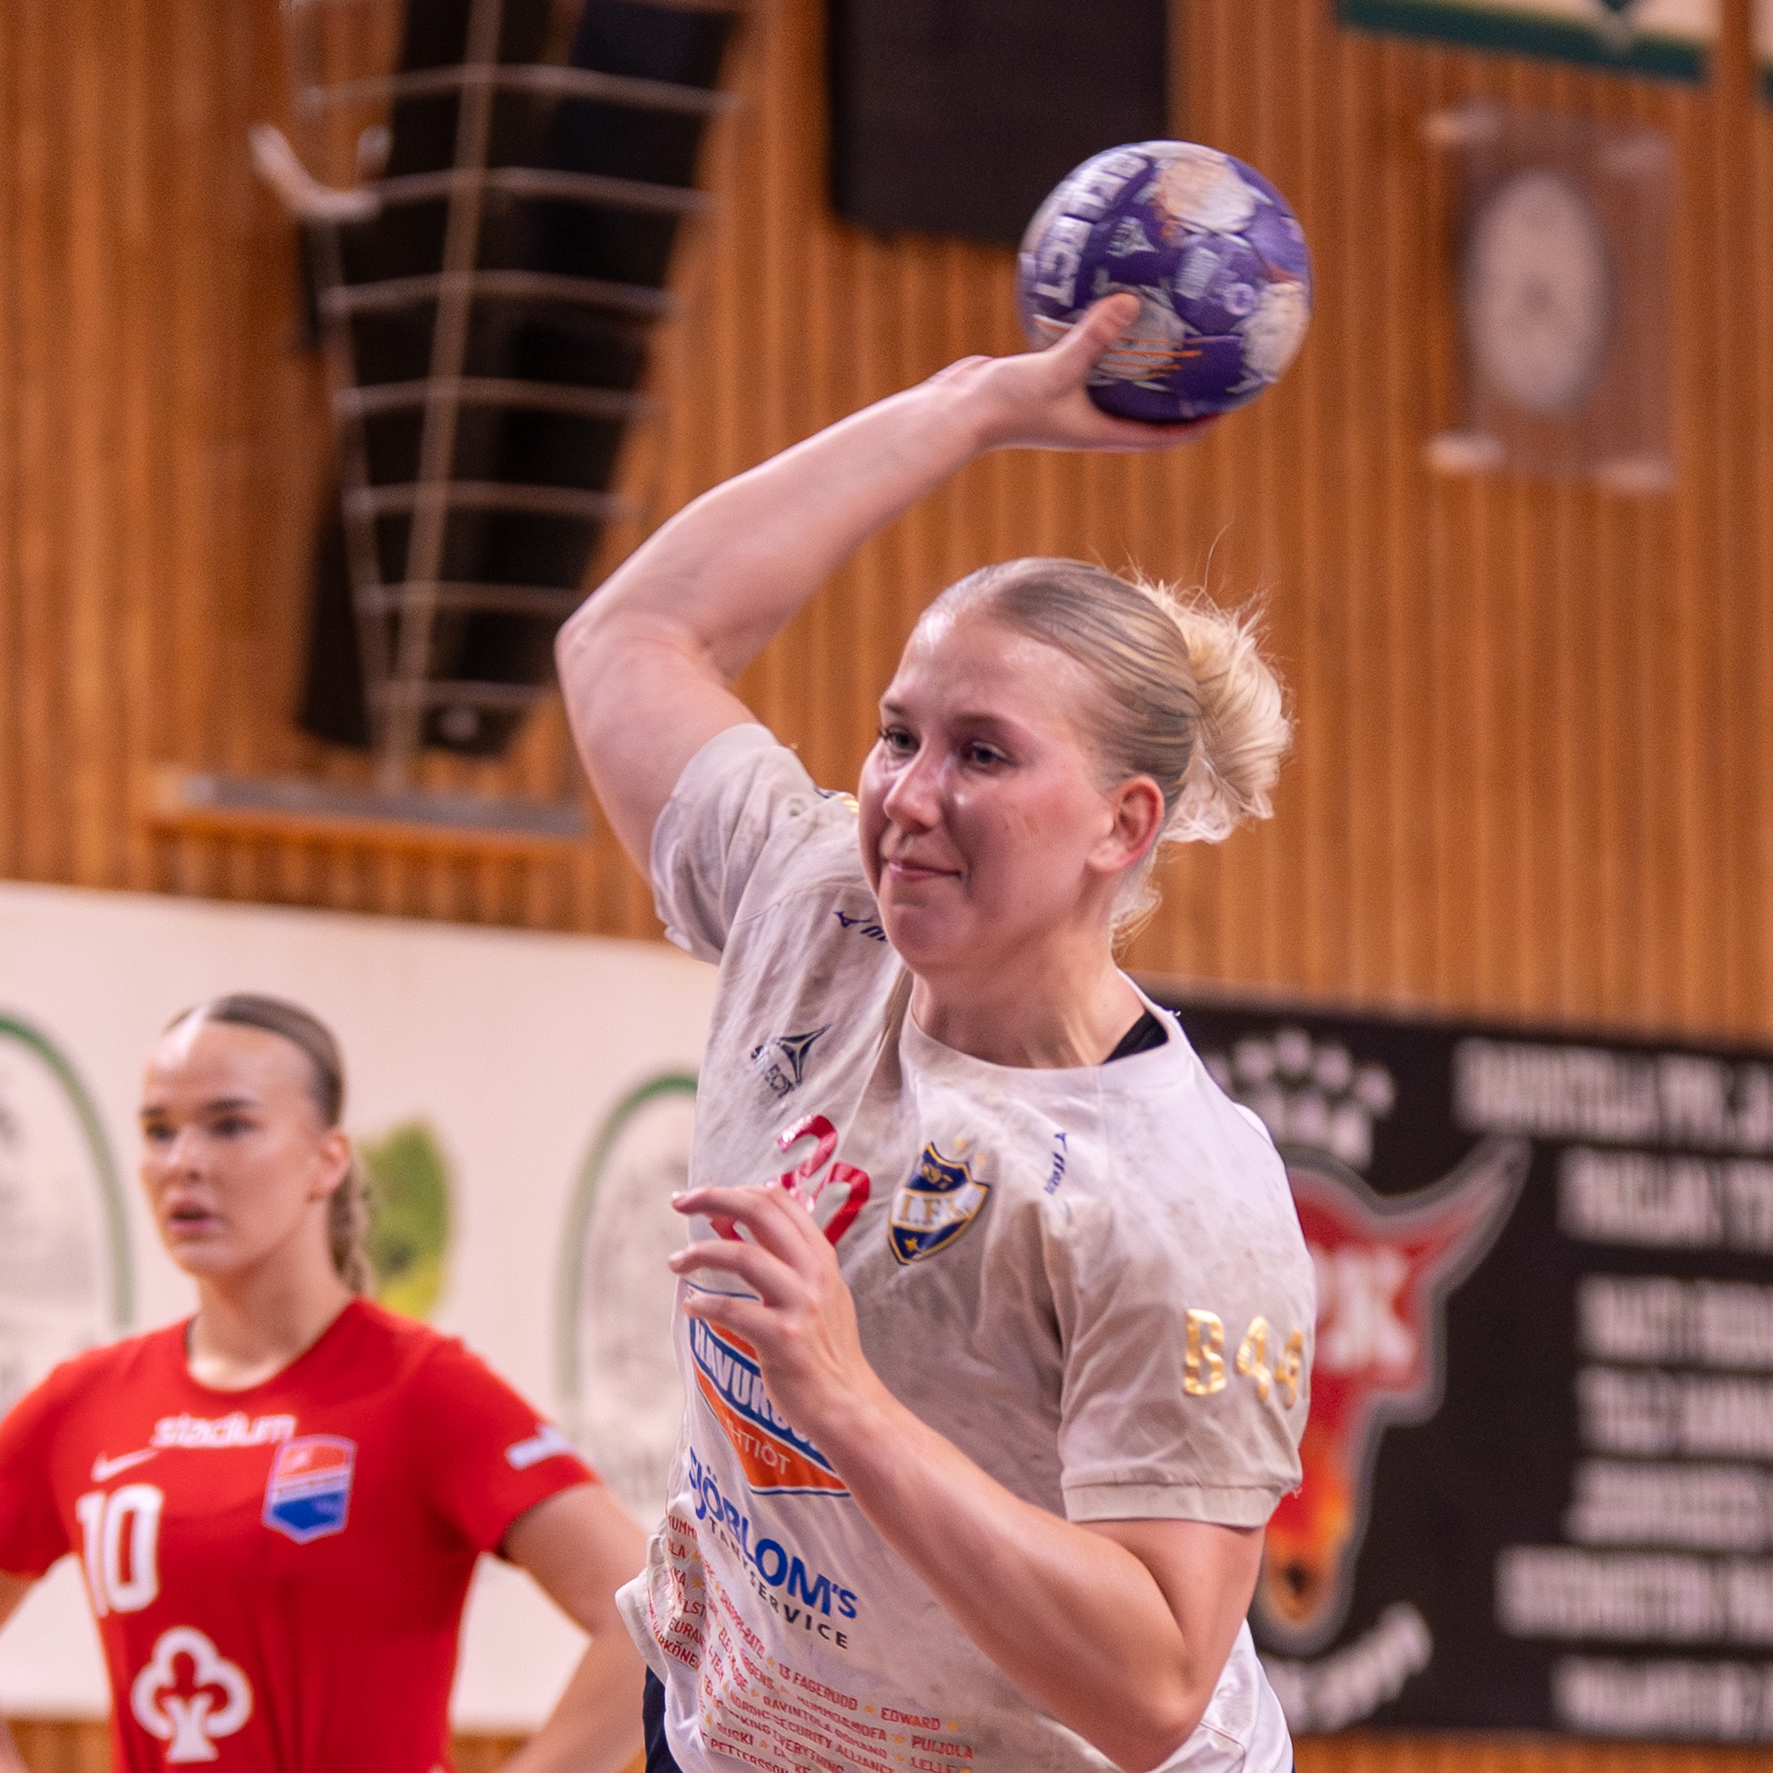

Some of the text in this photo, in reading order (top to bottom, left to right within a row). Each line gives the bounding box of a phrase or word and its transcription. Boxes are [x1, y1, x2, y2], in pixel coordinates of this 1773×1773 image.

[1183, 1308, 1305, 1411] B44
[150, 1411, 297, 1448] stadium
[74, 1481, 165, 1617] 10
[880, 1707, 941, 1731] EDWARD
